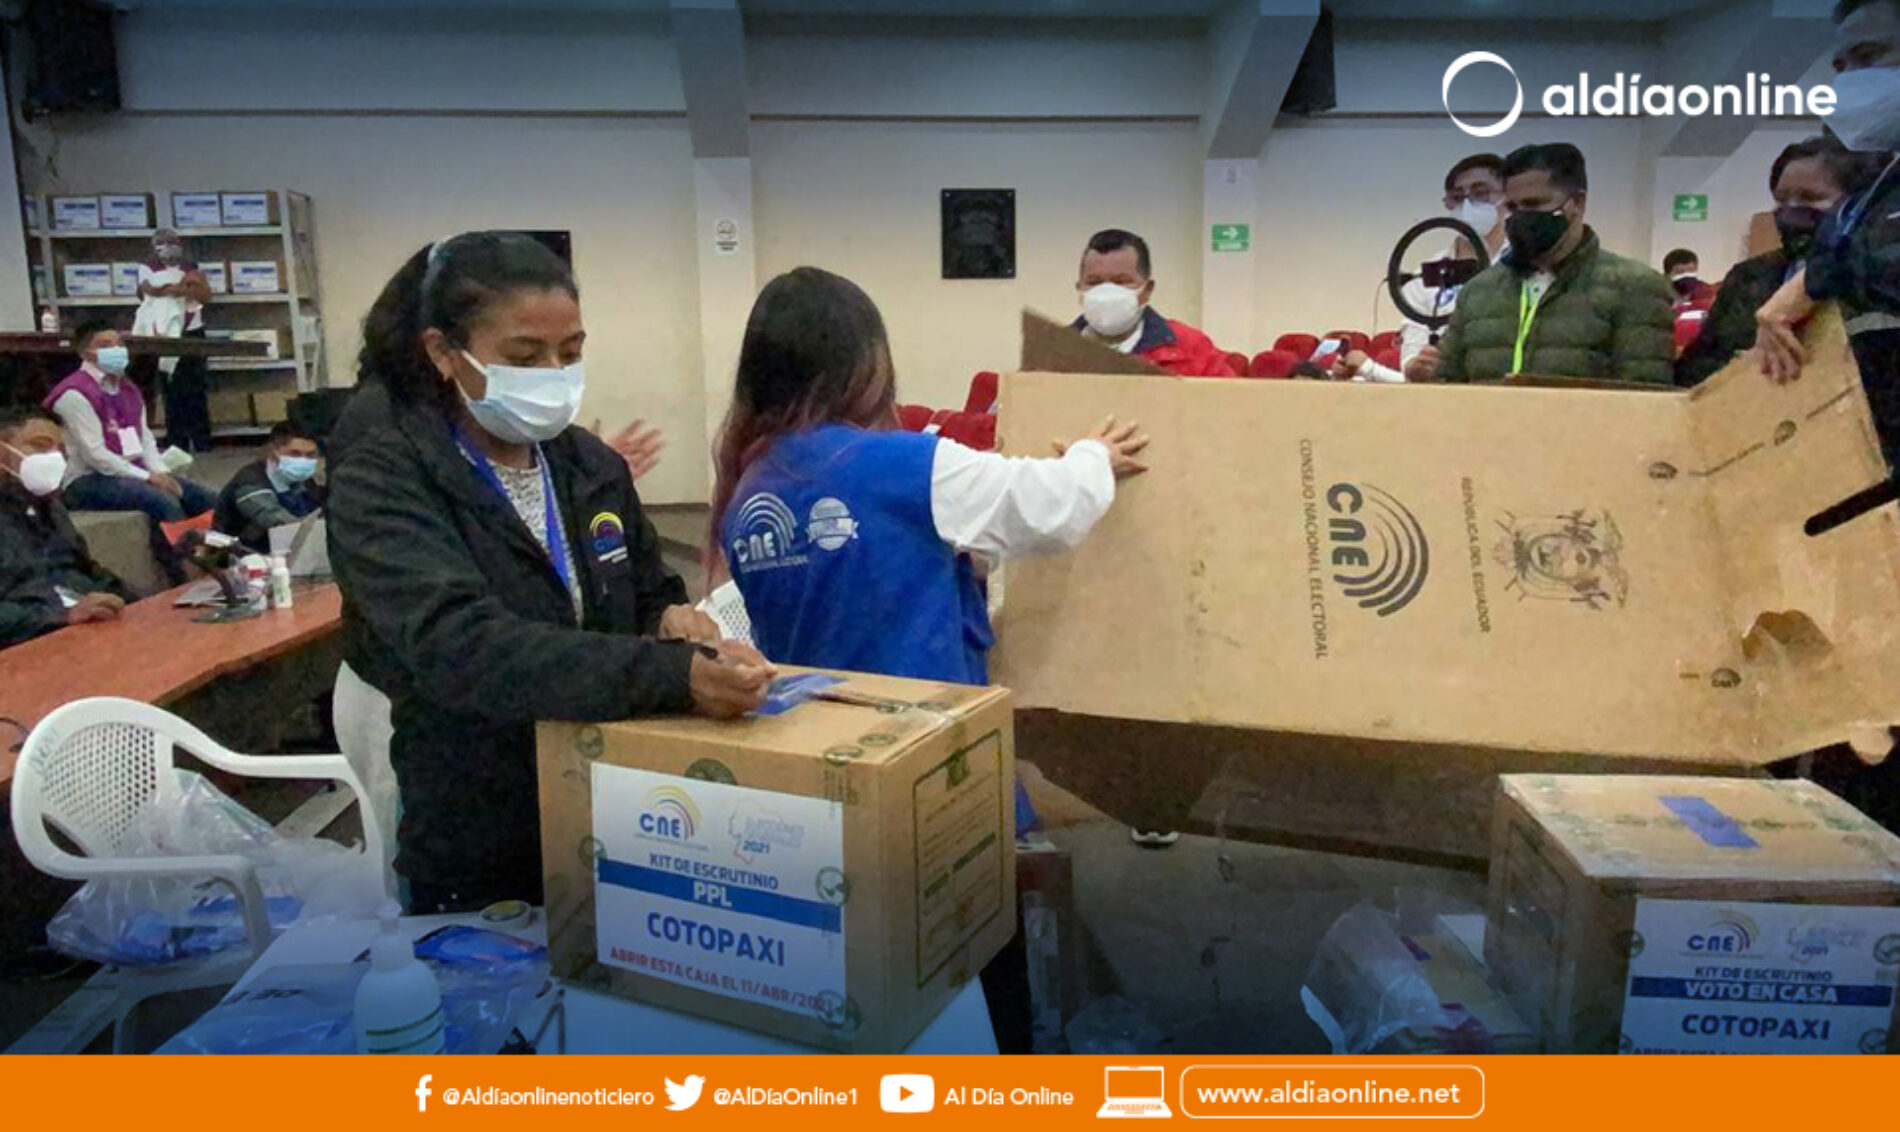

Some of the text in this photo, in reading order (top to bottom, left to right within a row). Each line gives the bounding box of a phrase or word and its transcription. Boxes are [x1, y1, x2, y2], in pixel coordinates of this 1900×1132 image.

[1299, 438, 1328, 660] CONSEJO NACIONAL ELECTORAL
[1469, 545, 1483, 568] DEL
[1472, 571, 1491, 634] ECUADOR
[742, 840, 770, 854] 2021
[649, 852, 779, 890] KIT DE ESCRUTINIO
[692, 880, 733, 907] PPL
[647, 911, 785, 967] COTOPAXI
[609, 946, 648, 967] ABRIR
[650, 955, 684, 976] ESTA
[685, 966, 719, 987] CAJA
[721, 974, 739, 991] EL
[1695, 966, 1833, 982] KIT DE ESCRUTINIO
[1685, 981, 1838, 1003] VOTO EN CASA
[1682, 1014, 1830, 1040] COTOPAXI
